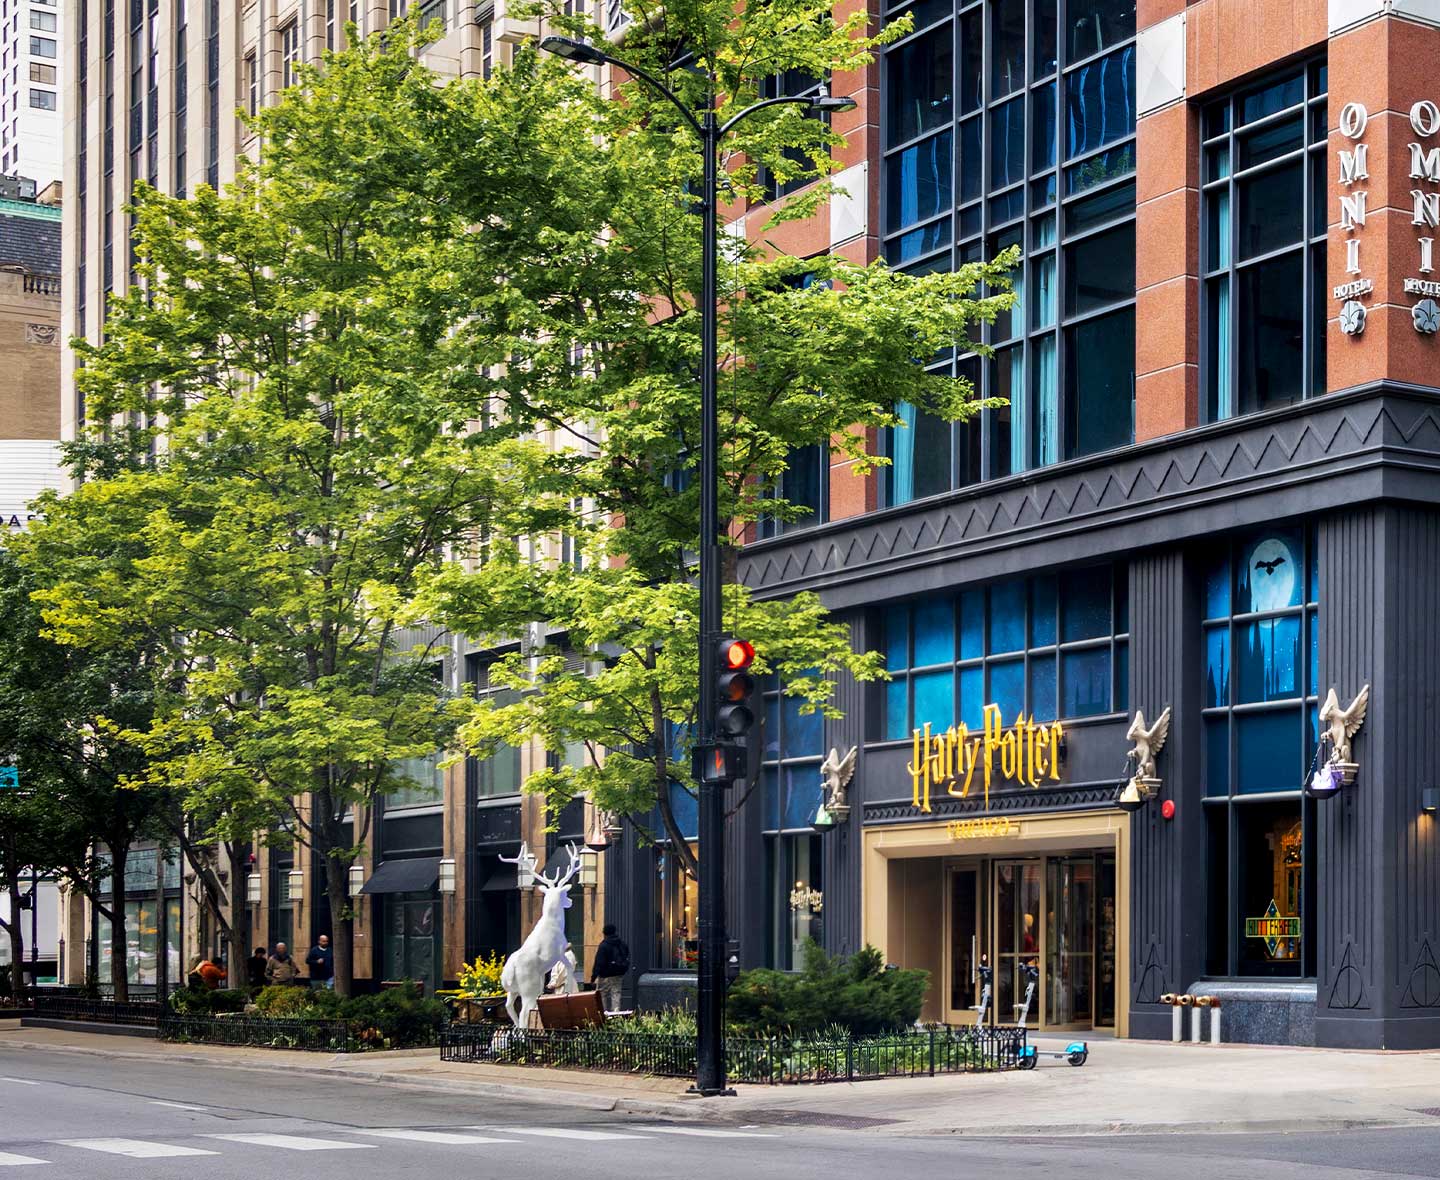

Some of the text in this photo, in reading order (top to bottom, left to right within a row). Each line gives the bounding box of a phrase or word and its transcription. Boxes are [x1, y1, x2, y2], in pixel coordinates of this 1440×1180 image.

[1337, 102, 1369, 275] OMNI
[1333, 278, 1373, 299] HOTEL
[907, 703, 1063, 815] Harry Potter
